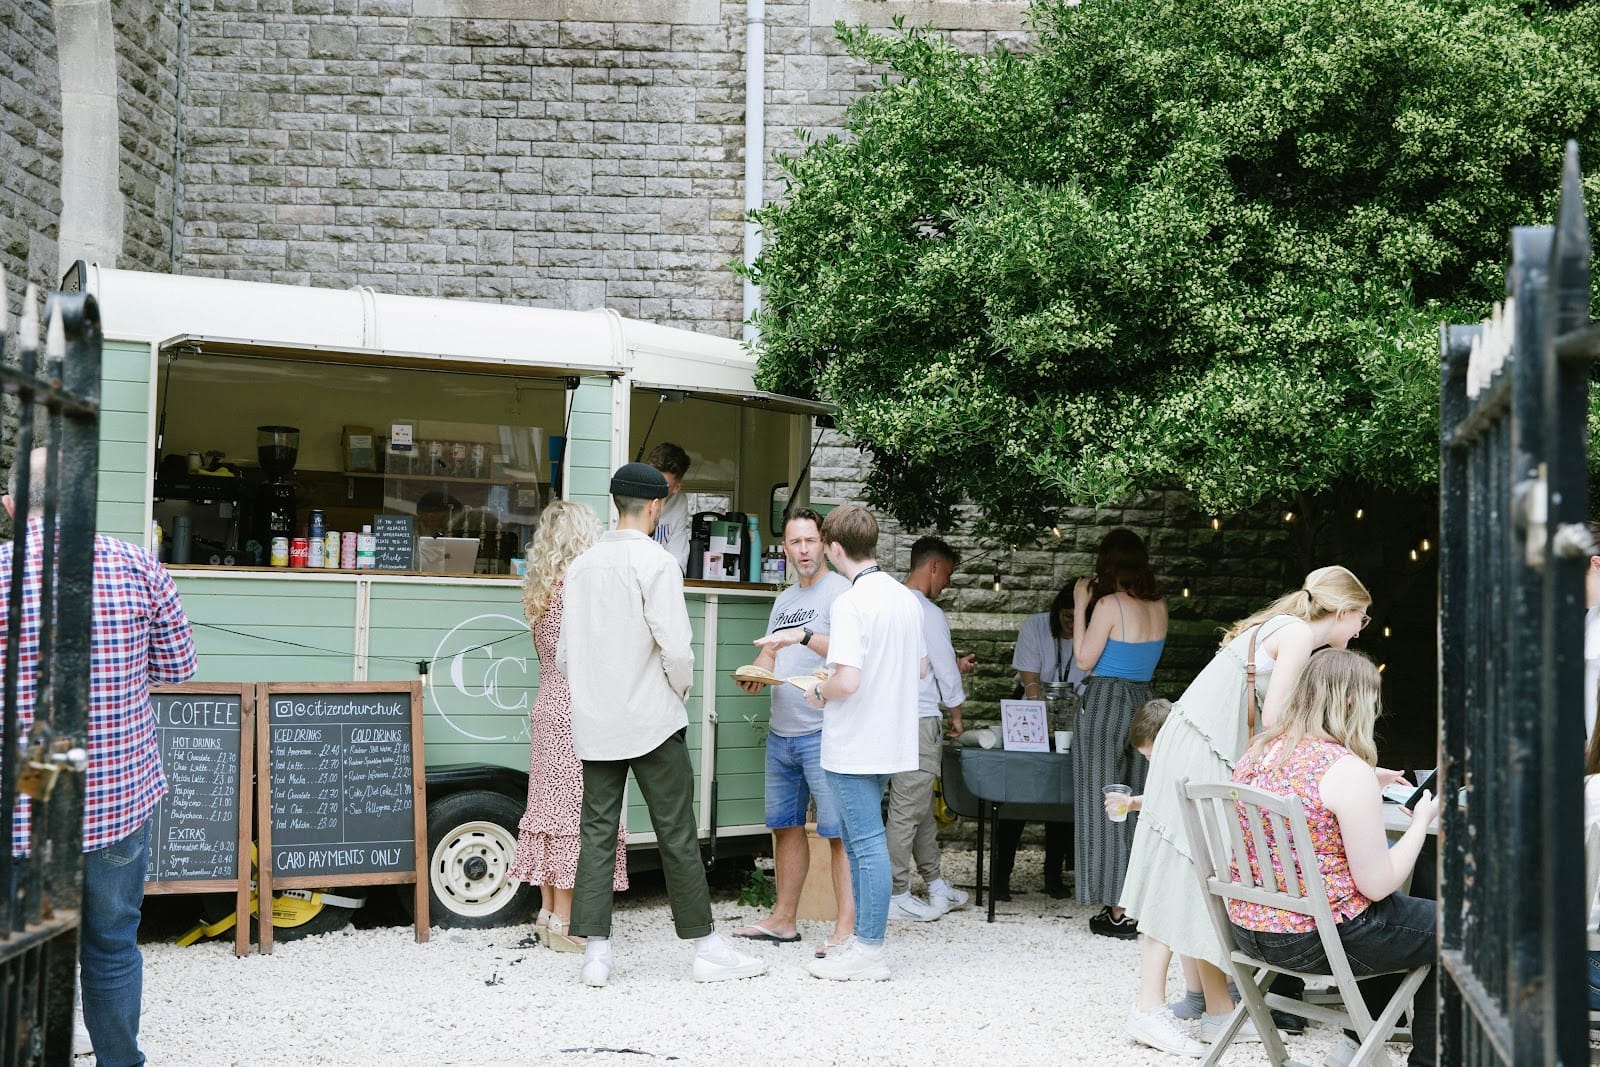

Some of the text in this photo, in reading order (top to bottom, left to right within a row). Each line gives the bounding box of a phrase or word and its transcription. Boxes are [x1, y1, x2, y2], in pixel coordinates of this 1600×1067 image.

[775, 608, 815, 626] Indian
[168, 701, 239, 726] COFFEE
[294, 700, 404, 716] @citizenchurchuk
[274, 728, 322, 742] ICED DRINKS
[351, 728, 402, 742] COLD DRINKS
[172, 737, 222, 749] HOT DRINKS
[173, 750, 184, 761] Hot
[286, 761, 304, 770] Latte
[168, 826, 206, 840] EXTRAS
[277, 848, 401, 870] CARD PAYMENTS ONLY
